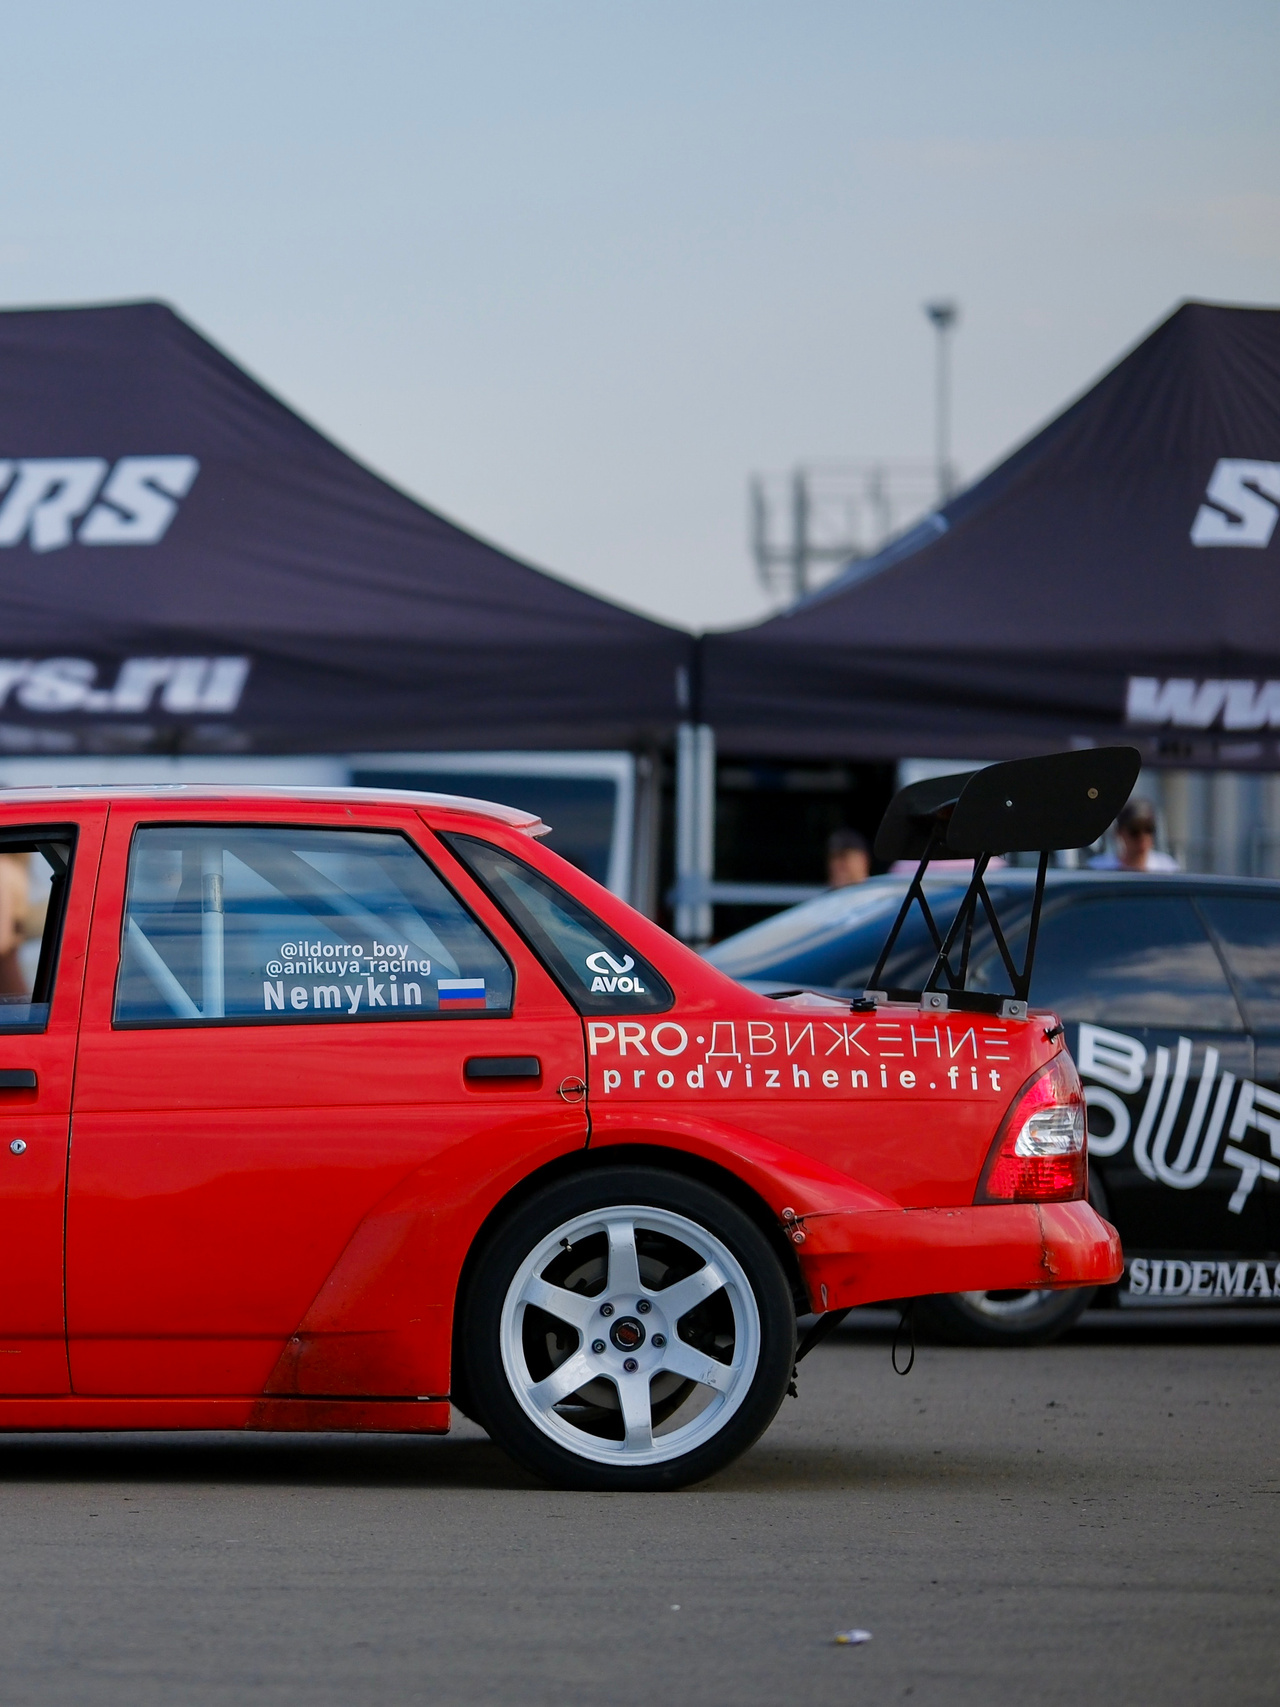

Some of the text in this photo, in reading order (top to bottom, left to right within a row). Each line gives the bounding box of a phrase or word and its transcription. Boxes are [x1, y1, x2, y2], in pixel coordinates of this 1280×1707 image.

[280, 941, 409, 961] @ildorro_boy
[266, 957, 431, 977] @anikuya_racing
[590, 976, 645, 993] AVOL
[263, 976, 422, 1014] Nemykin
[603, 1064, 1001, 1093] prodvizhenie.fit
